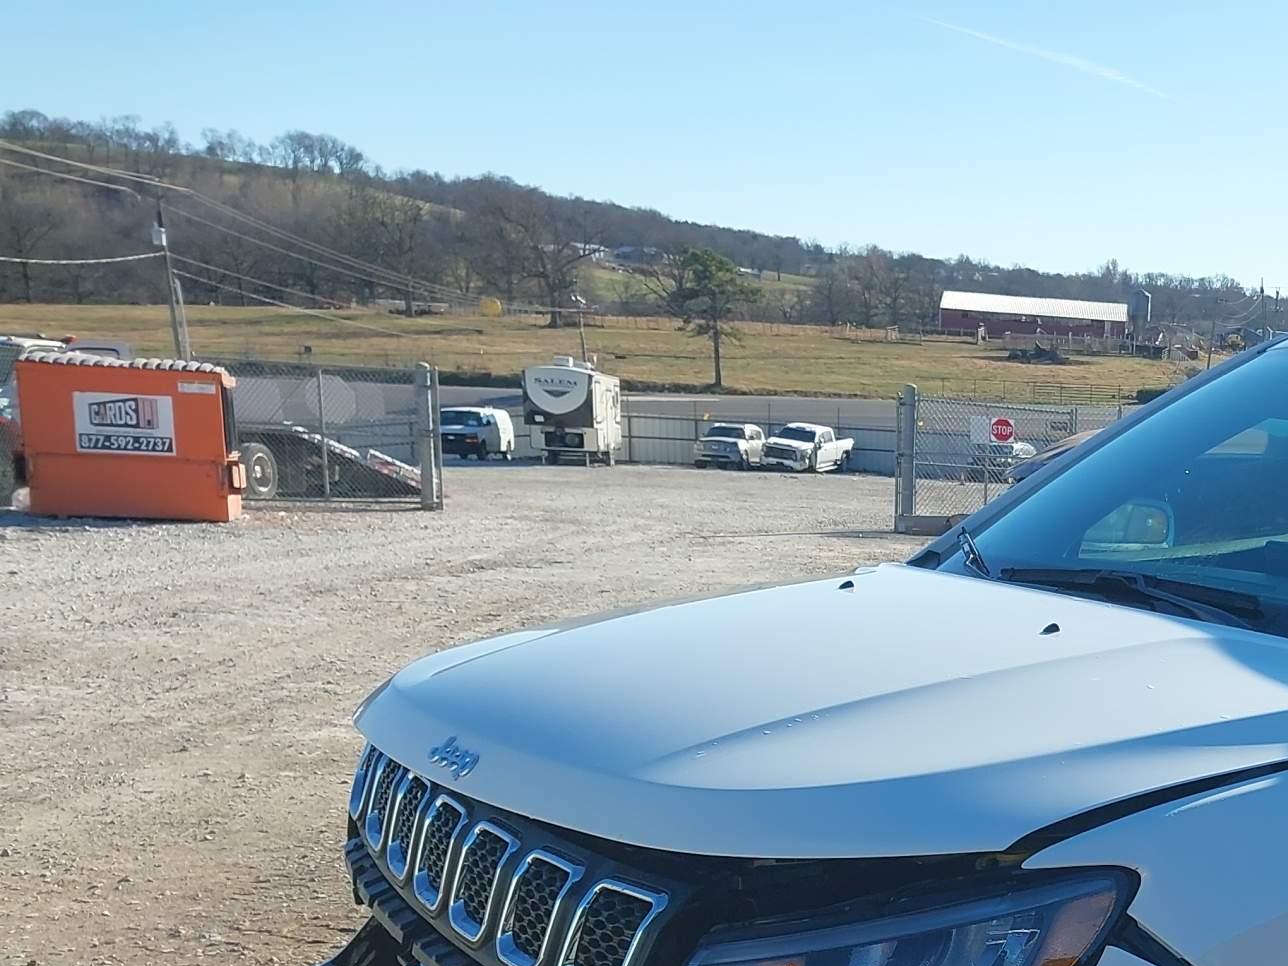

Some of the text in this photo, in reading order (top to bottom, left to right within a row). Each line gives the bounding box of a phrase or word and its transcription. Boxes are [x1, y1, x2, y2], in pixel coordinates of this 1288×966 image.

[90, 401, 136, 425] CARDS
[992, 425, 1013, 436] STOP
[81, 436, 169, 451] 877-592-2737
[428, 736, 480, 781] Jeep
